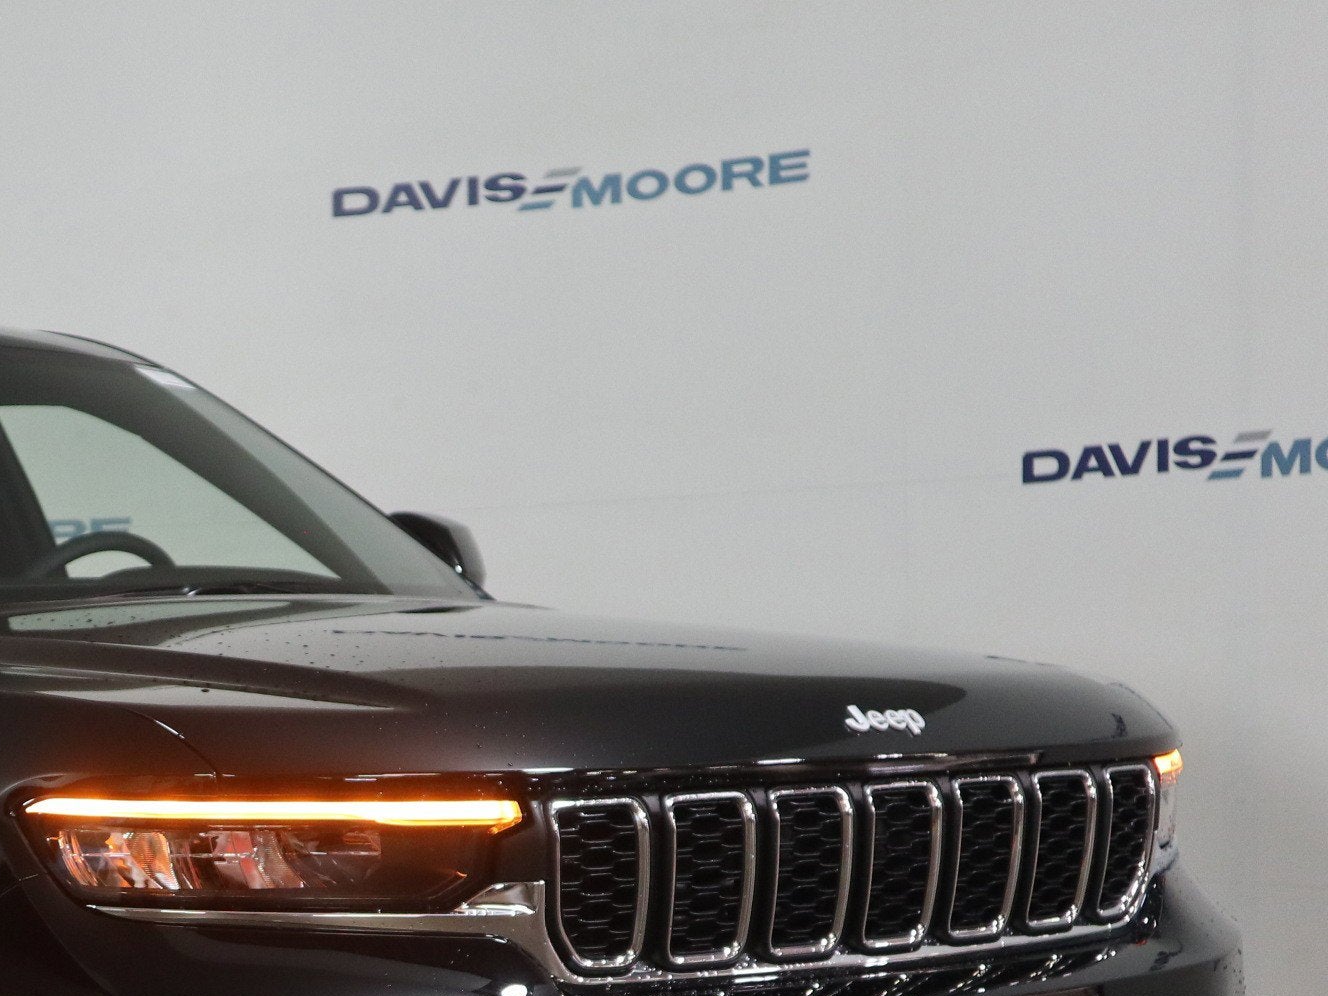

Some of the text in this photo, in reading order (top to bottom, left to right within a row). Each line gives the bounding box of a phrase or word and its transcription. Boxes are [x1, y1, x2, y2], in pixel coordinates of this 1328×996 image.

[332, 148, 811, 218] DAVIS MOORE
[1022, 434, 1328, 484] DAVIS M
[845, 704, 926, 736] Jeep
